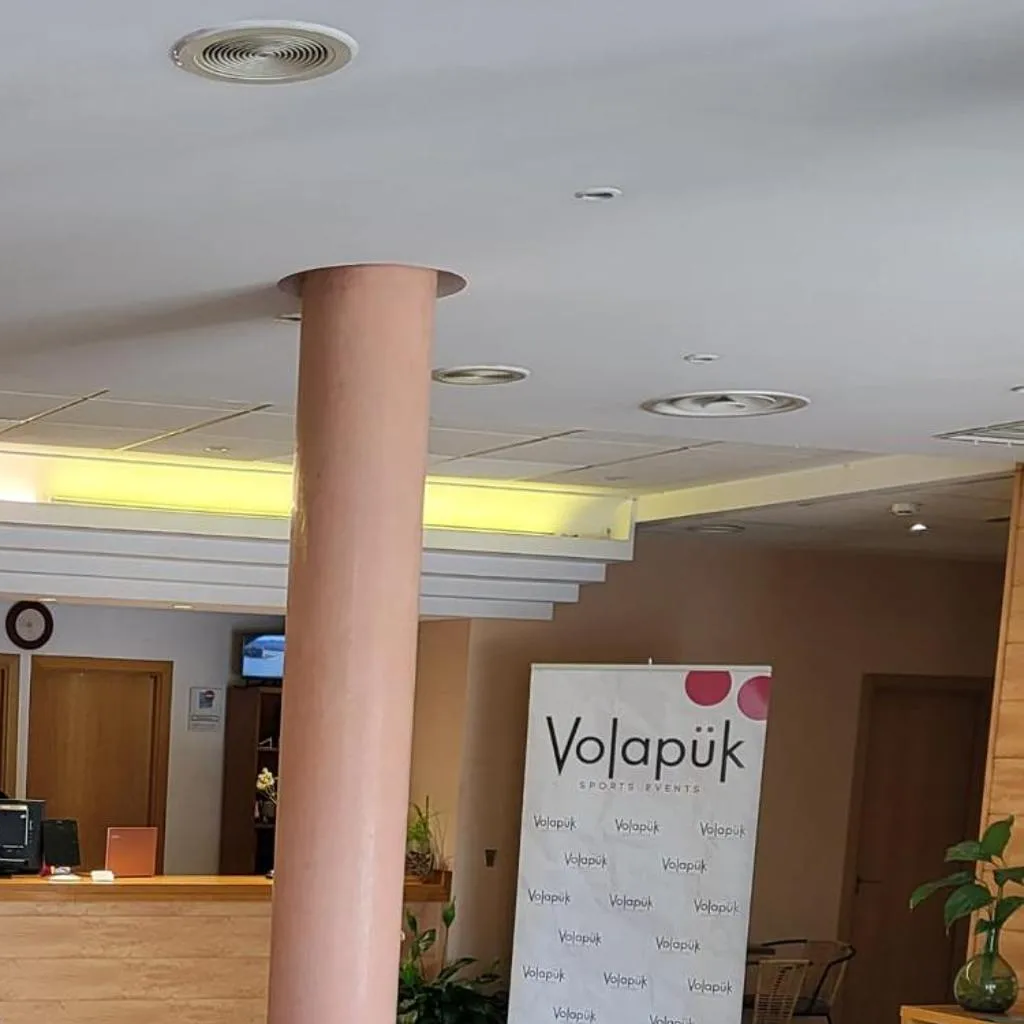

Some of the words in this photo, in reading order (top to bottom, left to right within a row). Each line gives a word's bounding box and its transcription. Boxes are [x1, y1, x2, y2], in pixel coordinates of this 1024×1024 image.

[546, 716, 745, 783] Volapük
[579, 782, 635, 791] SPORTS
[645, 784, 701, 794] EVENTS
